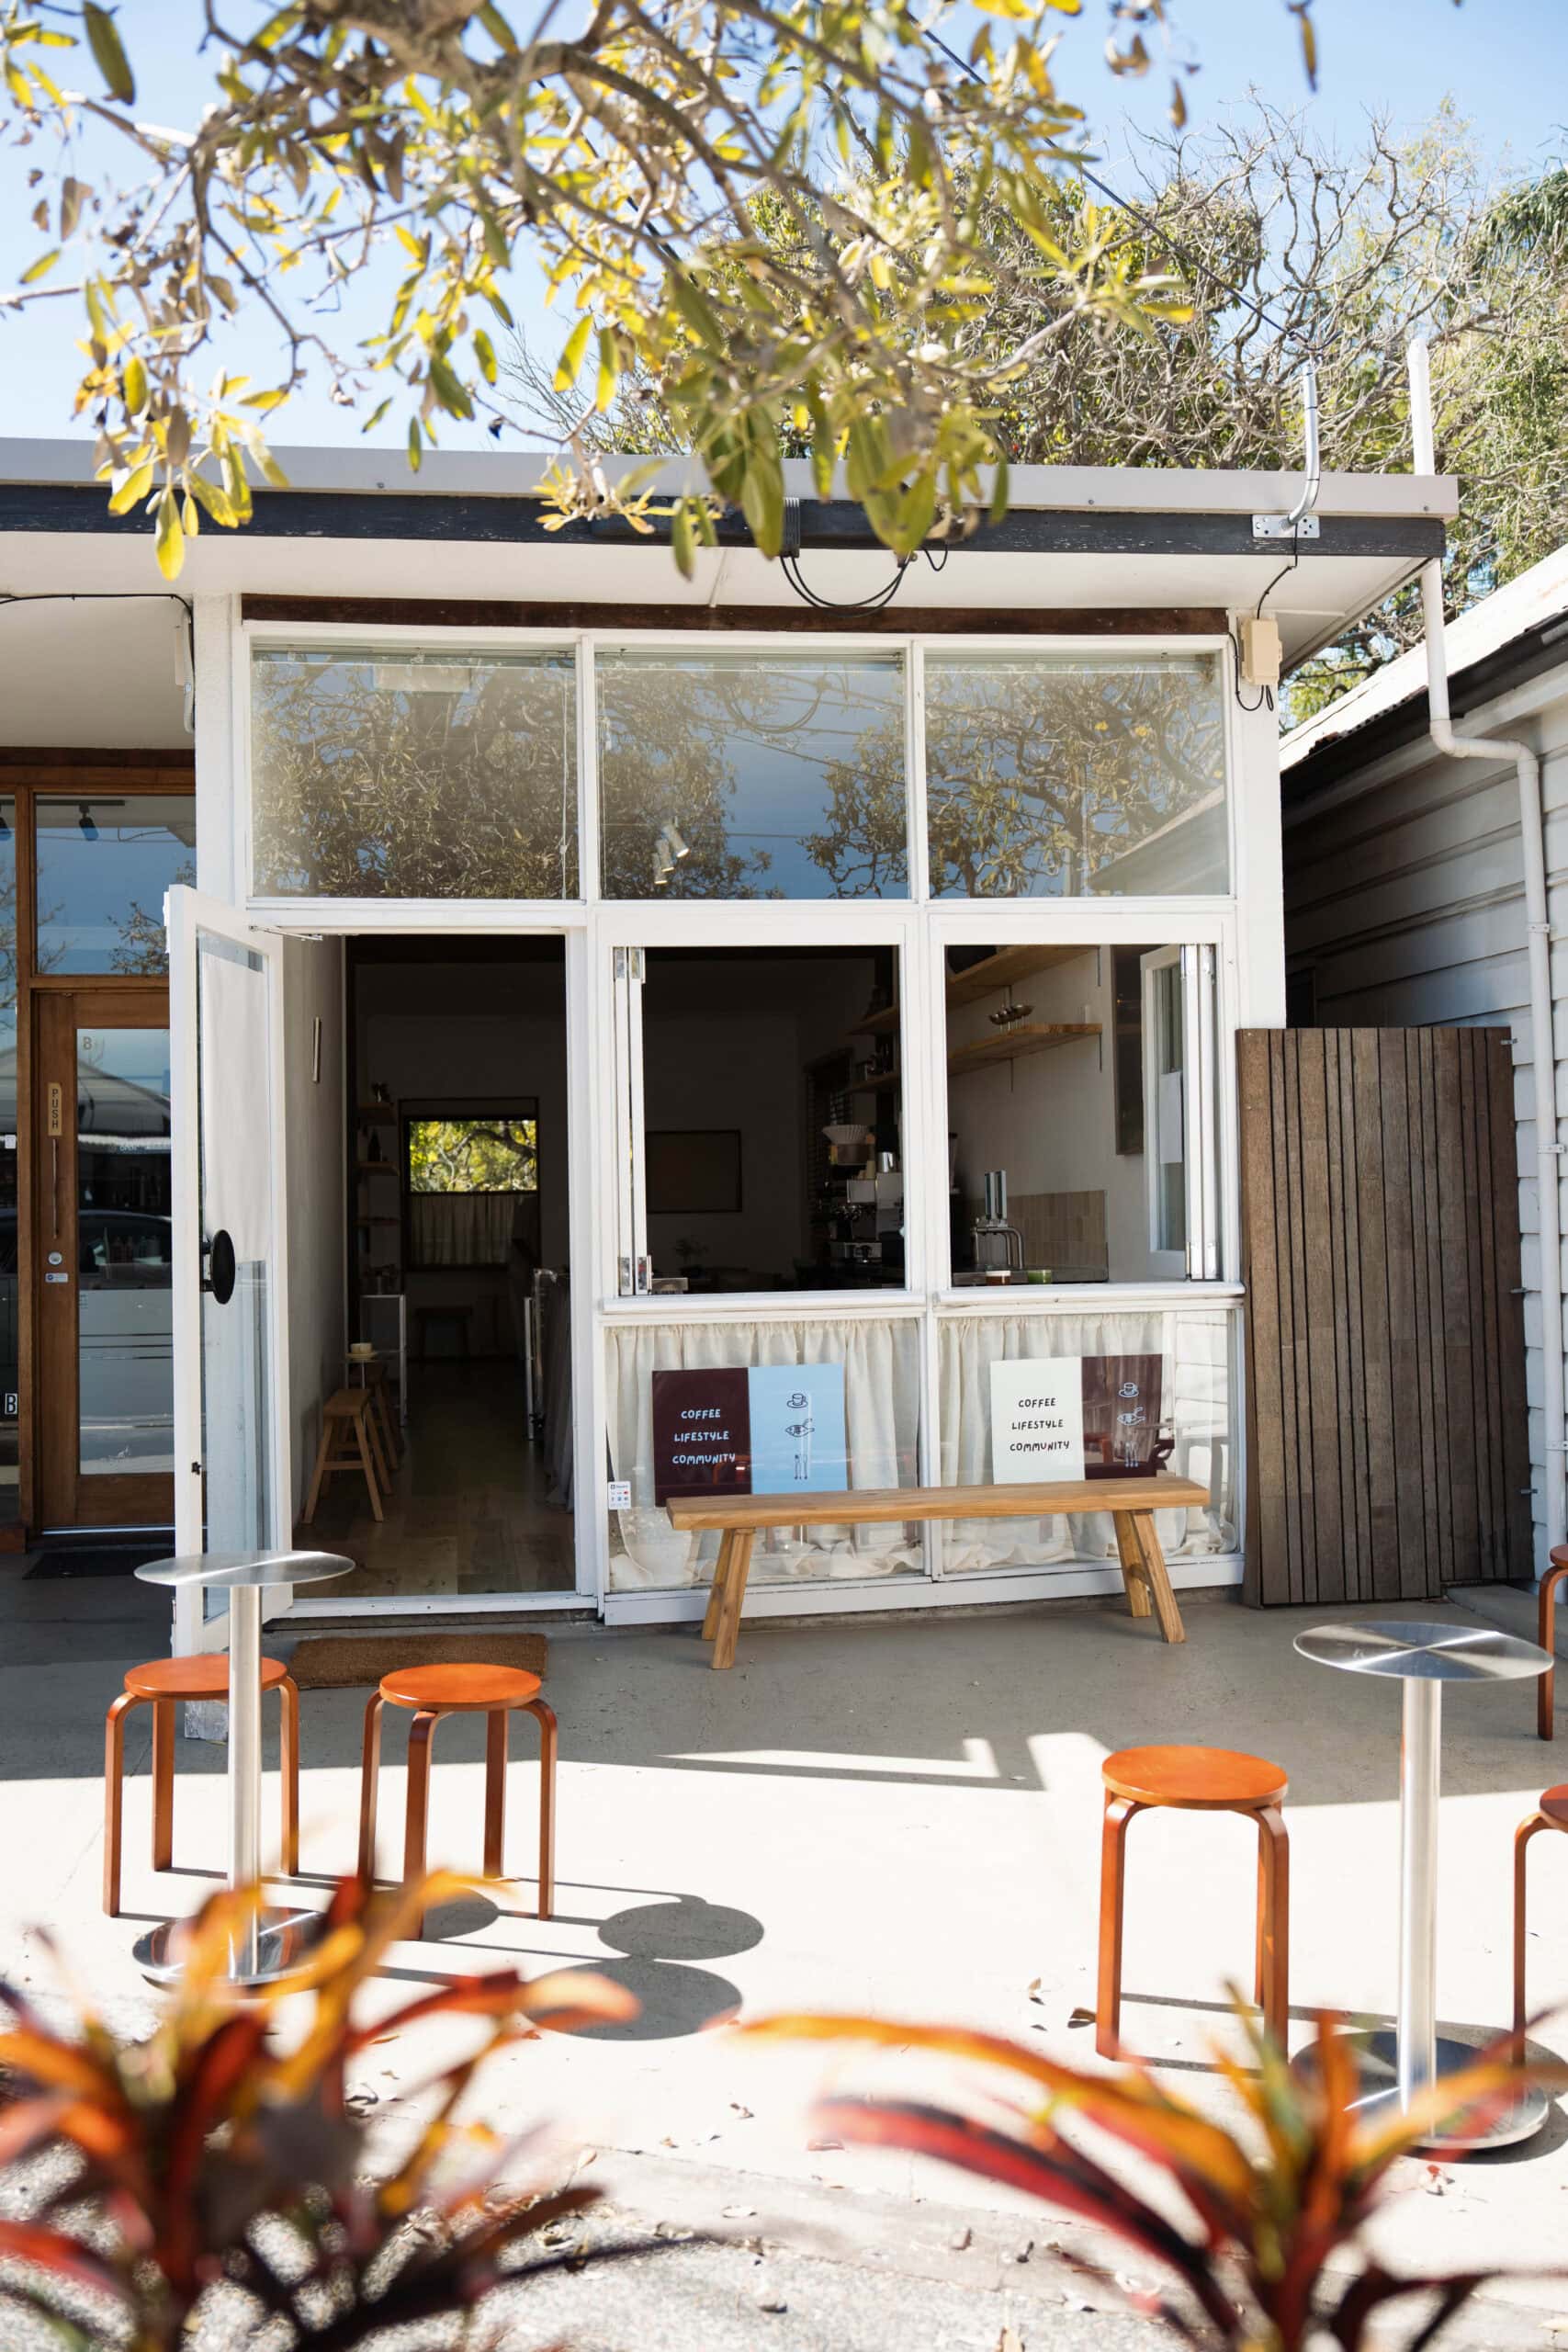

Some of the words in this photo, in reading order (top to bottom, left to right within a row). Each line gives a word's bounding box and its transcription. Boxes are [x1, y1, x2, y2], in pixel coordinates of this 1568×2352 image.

[1018, 1397, 1056, 1408] COFFEE
[681, 1408, 721, 1419] COFFEE
[1011, 1419, 1064, 1430] LIFESTYLE
[674, 1430, 729, 1442] LIFESTYLE
[1010, 1441, 1069, 1452] COMMUNITY
[672, 1453, 735, 1464] COMMUNITY
